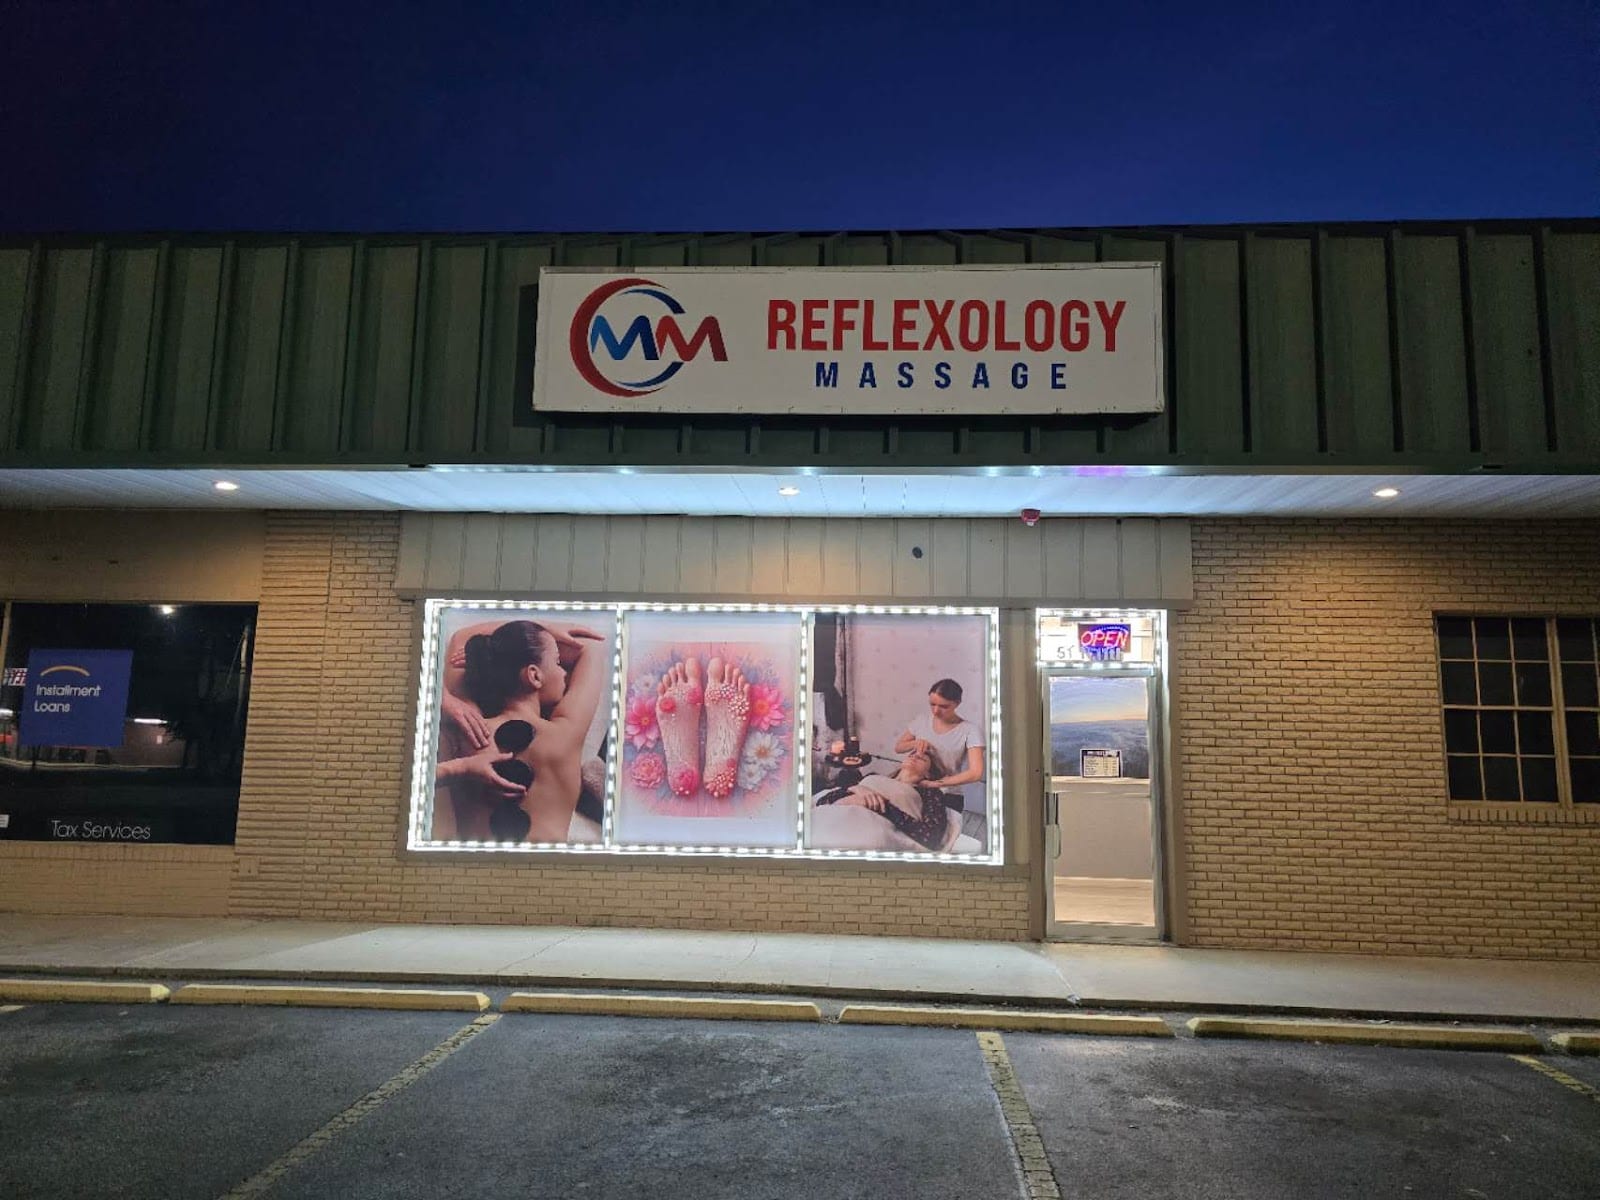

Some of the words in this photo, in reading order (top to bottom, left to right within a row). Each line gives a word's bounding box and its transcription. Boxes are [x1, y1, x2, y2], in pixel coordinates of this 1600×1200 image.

[767, 299, 1126, 352] REFLEXOLOGY
[815, 362, 1067, 389] MASSAGE
[1080, 629, 1128, 649] OPEN
[36, 684, 101, 697] Installment
[34, 700, 71, 713] Loans
[51, 820, 78, 838] Tax
[82, 821, 151, 840] Services
